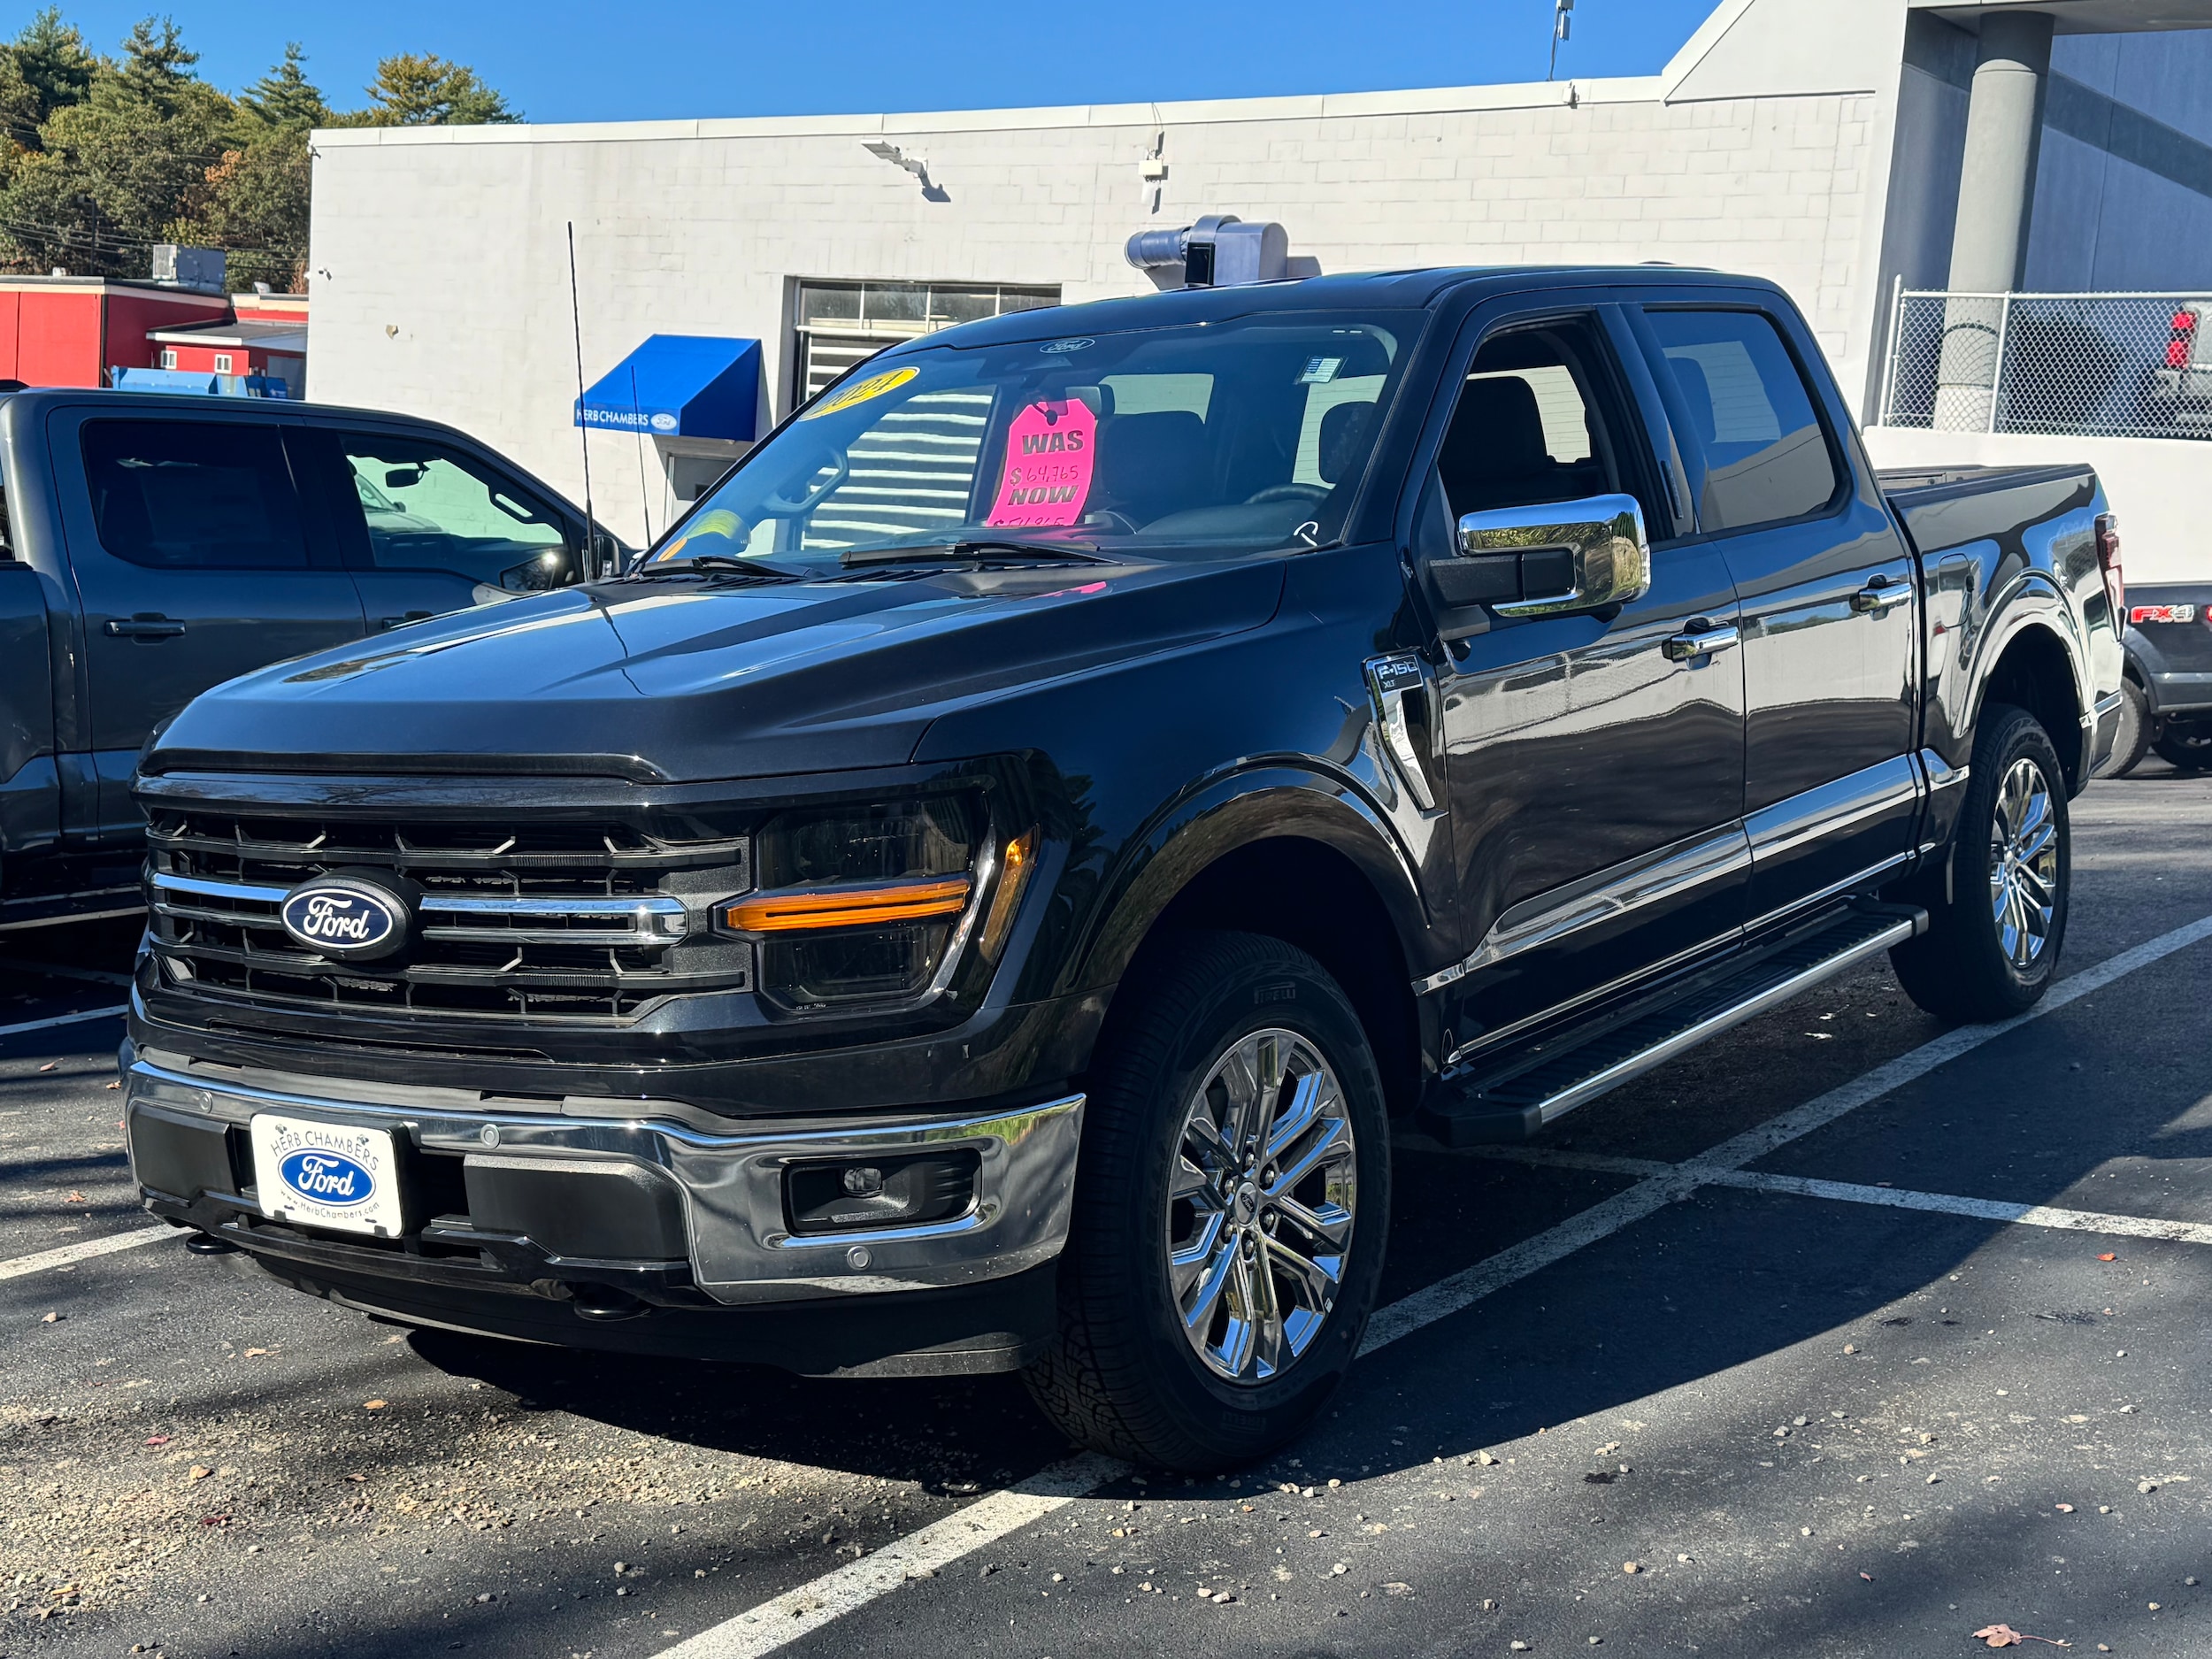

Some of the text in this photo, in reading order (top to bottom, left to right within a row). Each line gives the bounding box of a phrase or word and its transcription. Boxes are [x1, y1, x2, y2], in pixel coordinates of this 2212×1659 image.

[1047, 340, 1087, 351] Ford
[599, 410, 649, 426] CHAMBERS
[1022, 429, 1084, 455] WAS
[1008, 485, 1079, 506] NOW
[2131, 604, 2194, 623] FX4
[1377, 661, 1418, 679] F-150
[1383, 680, 1395, 688] XLT
[303, 895, 370, 939] Ford
[1254, 981, 1296, 1004] PIRELLI
[271, 1131, 379, 1171] HERB CHAMBERS
[297, 1156, 355, 1196] Ford
